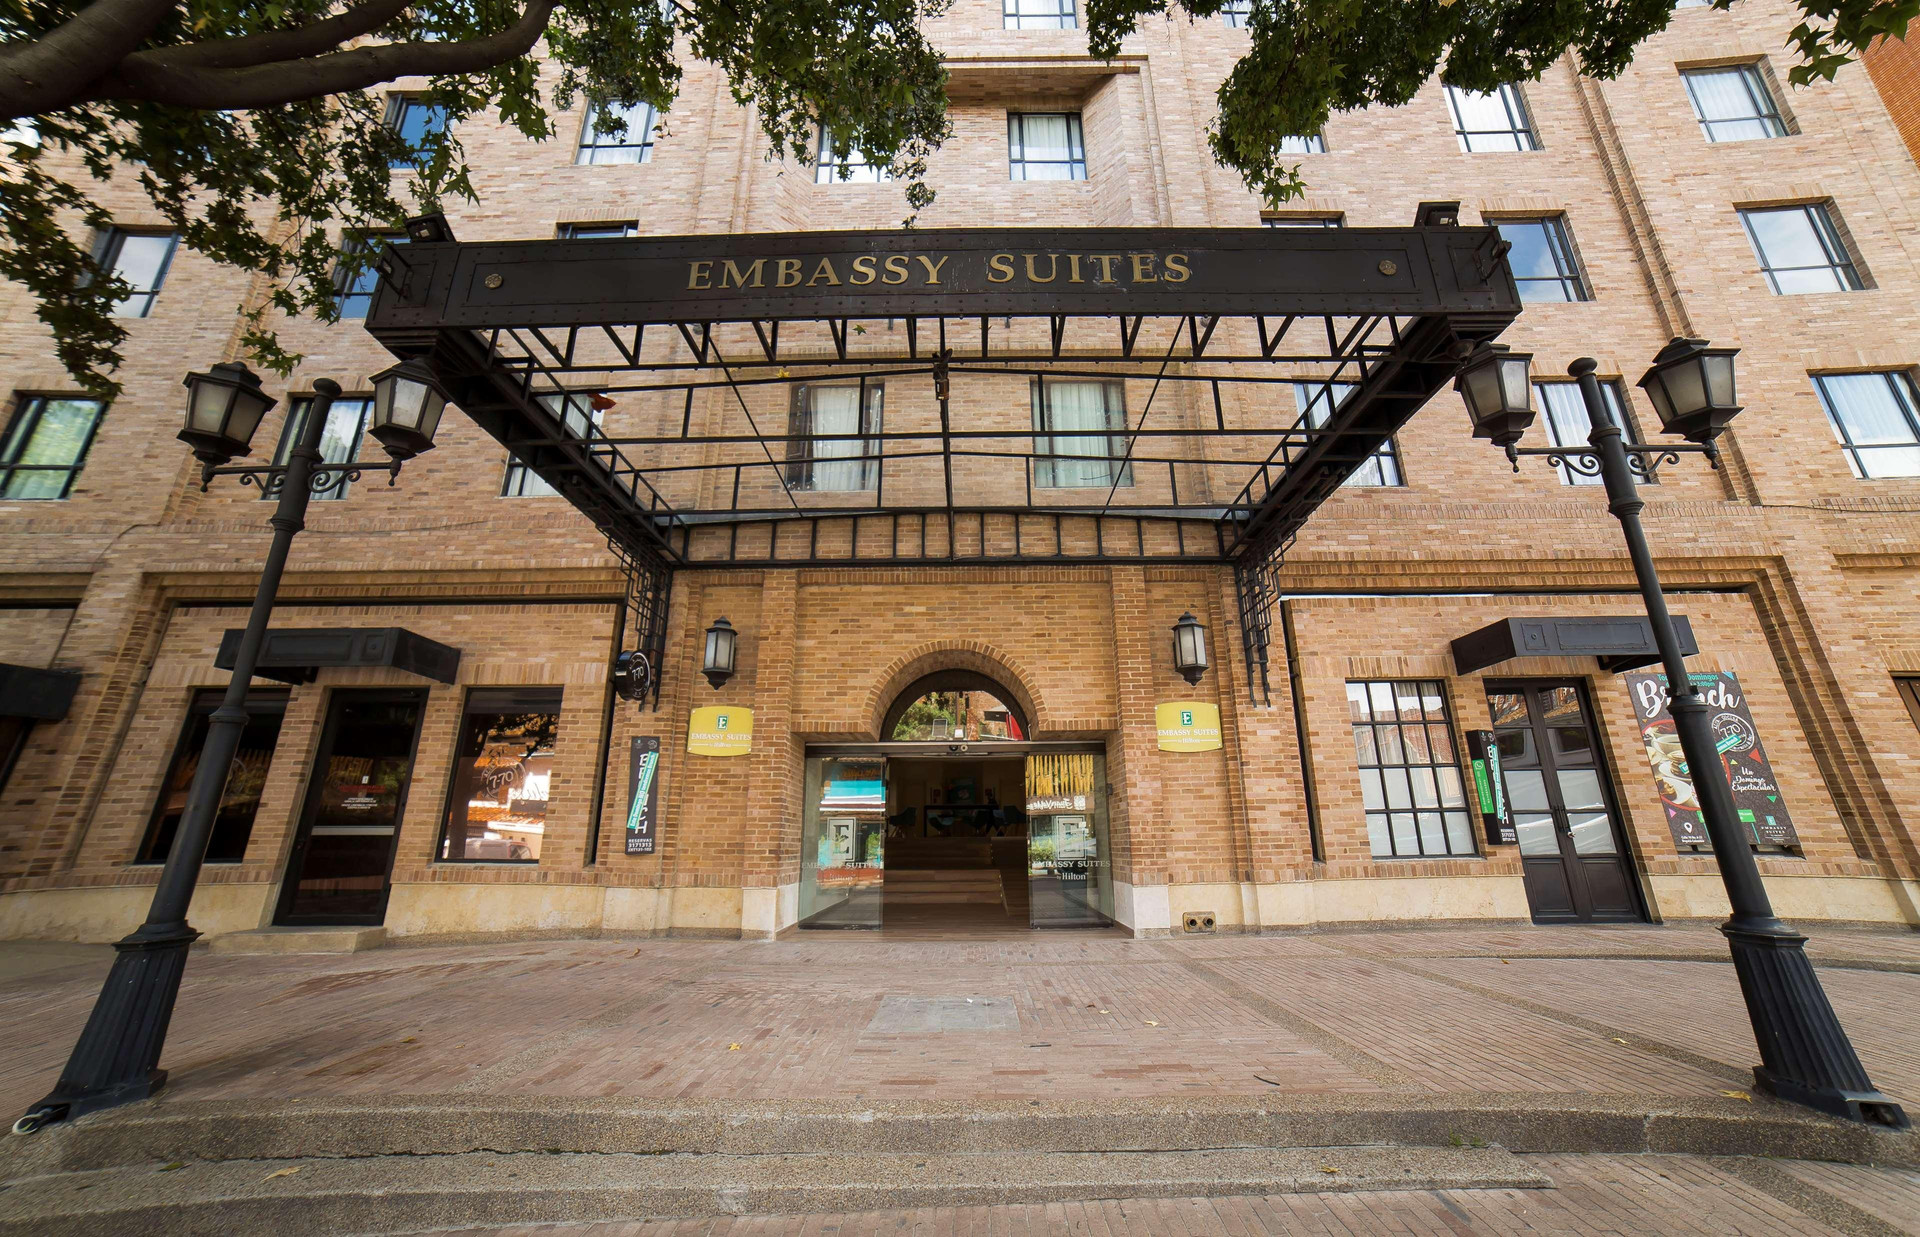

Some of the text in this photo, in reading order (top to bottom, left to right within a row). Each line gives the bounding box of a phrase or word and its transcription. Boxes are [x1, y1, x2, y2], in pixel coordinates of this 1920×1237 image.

[686, 253, 1191, 290] EMBASSY SUITES
[718, 717, 727, 729] E
[1183, 712, 1192, 724] E
[1741, 766, 1754, 775] Un
[490, 770, 513, 788] 7-70
[1734, 775, 1766, 786] Domingo
[1732, 782, 1776, 793] Espectacular
[833, 824, 849, 854] E
[1078, 860, 1111, 868] SUITES
